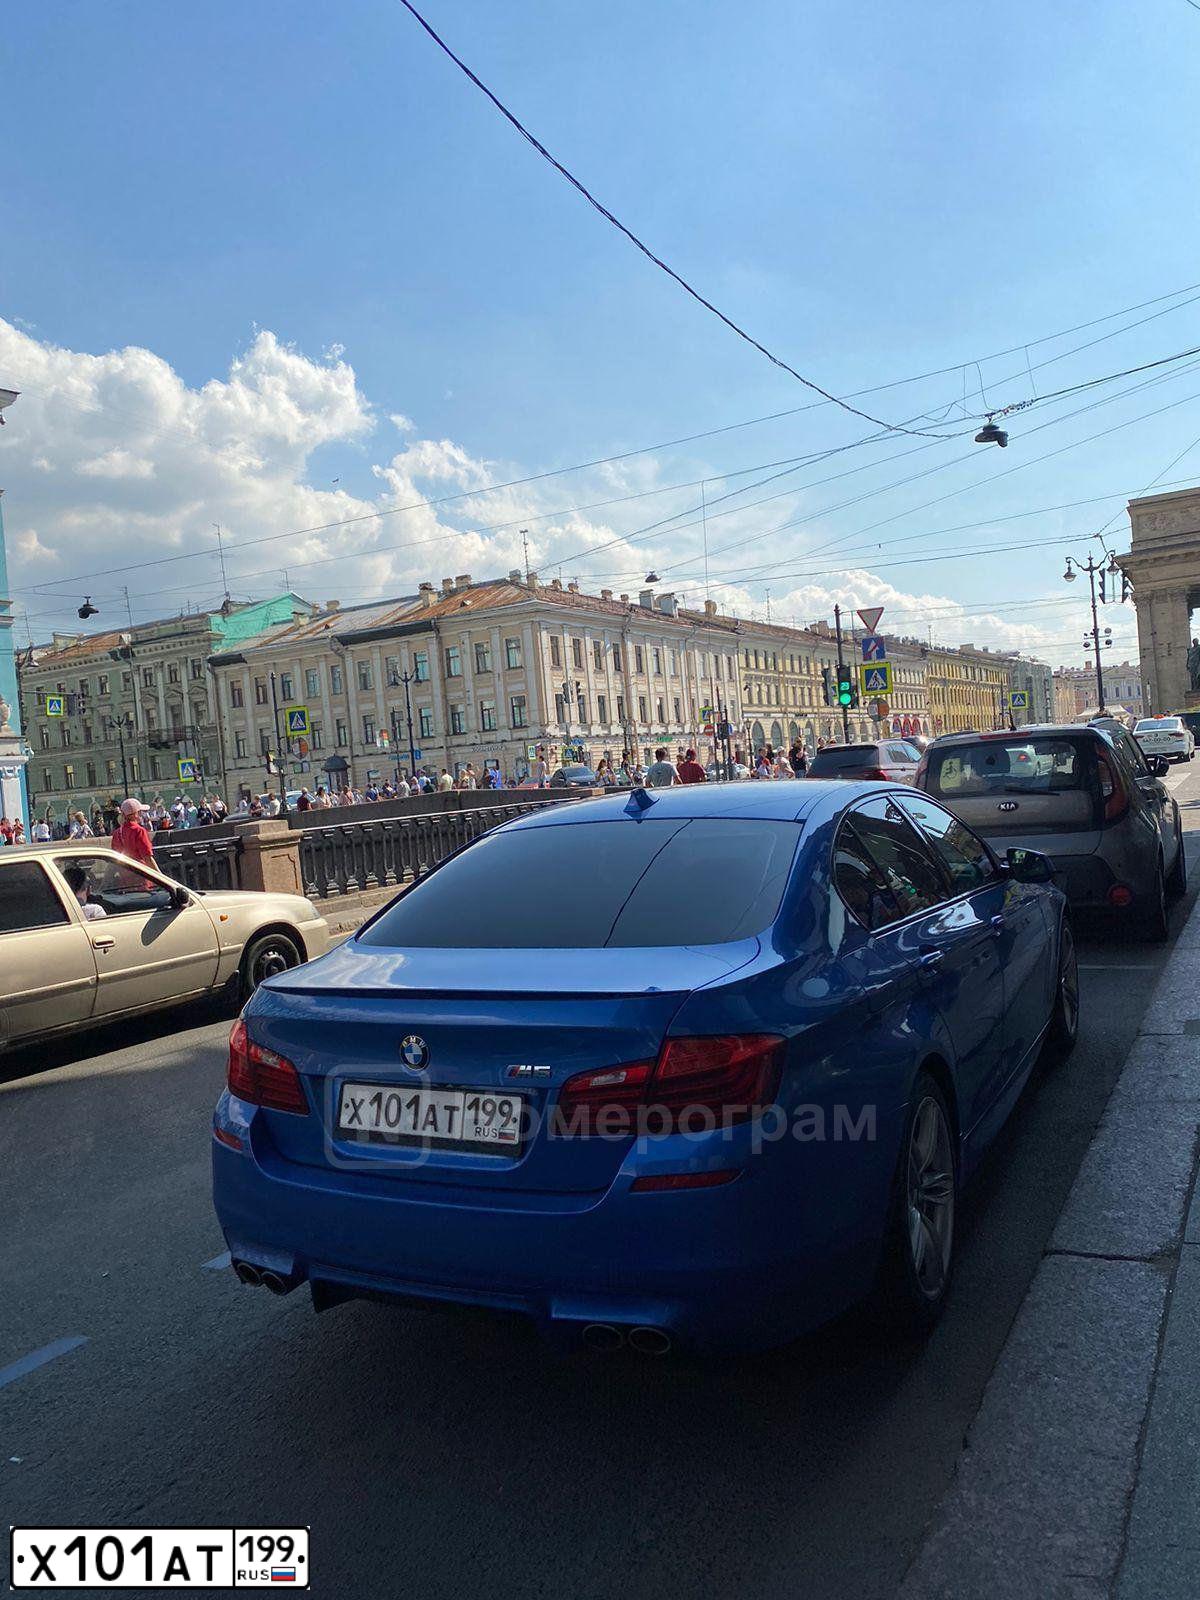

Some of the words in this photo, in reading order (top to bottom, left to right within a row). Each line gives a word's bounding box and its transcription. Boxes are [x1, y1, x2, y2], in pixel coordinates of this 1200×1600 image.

[348, 1091, 460, 1134] Х101АТ
[467, 1097, 514, 1128] 199
[474, 1126, 498, 1139] RUS
